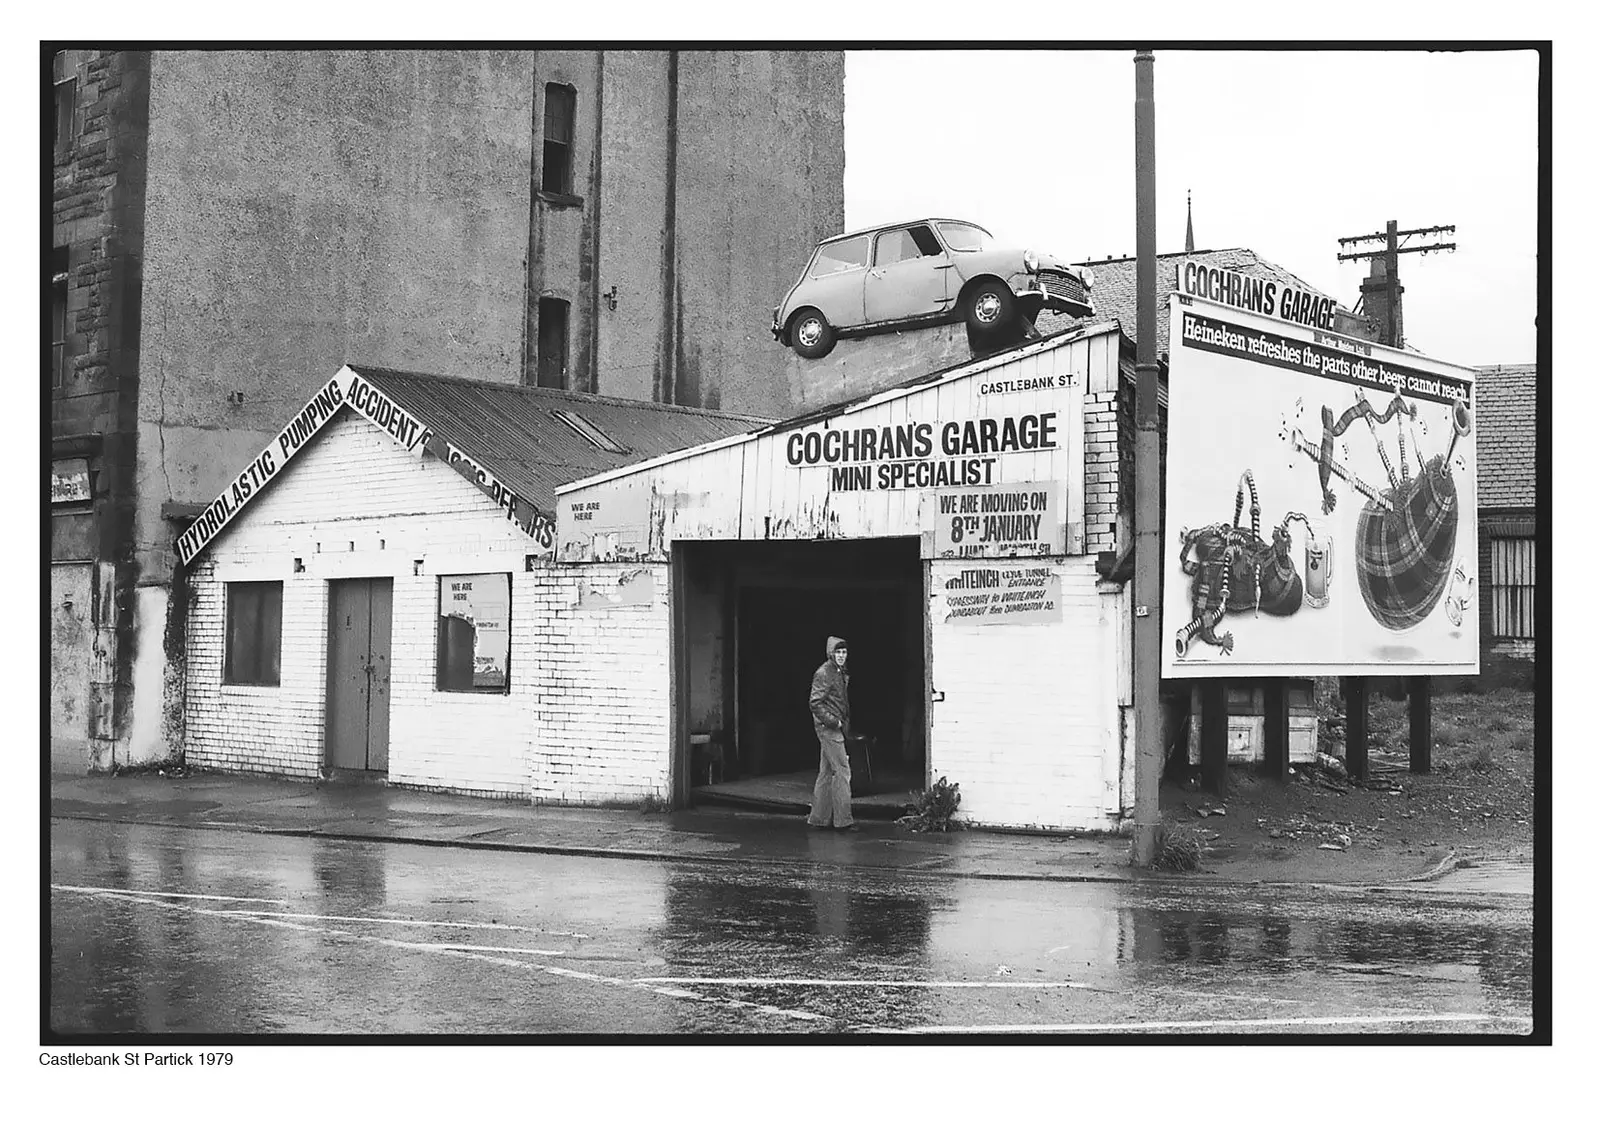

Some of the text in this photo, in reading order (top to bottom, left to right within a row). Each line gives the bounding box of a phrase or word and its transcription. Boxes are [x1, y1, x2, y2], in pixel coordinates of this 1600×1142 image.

[1185, 262, 1337, 332] COCHRANS GARAGE
[1183, 315, 1246, 351] Heineken
[1248, 334, 1301, 365] refreshes
[1302, 346, 1321, 369] the
[1321, 354, 1350, 375] parts
[1351, 360, 1378, 382] other
[1379, 364, 1406, 389] beers
[1407, 375, 1441, 396] cannot
[980, 373, 1077, 396] CASTLEBANK ST.
[786, 412, 1057, 466] COCHRAN'S GARAGE
[179, 379, 344, 561] HYDROLASTIC PUMPING
[831, 458, 996, 492] MINI SPECIALIST
[571, 501, 600, 512] WE ARE
[573, 511, 593, 521] HERE
[940, 491, 1047, 514] WE ARE MOVING ON
[951, 514, 1041, 543] 8TH JANUARY
[451, 582, 472, 592] WE ARE
